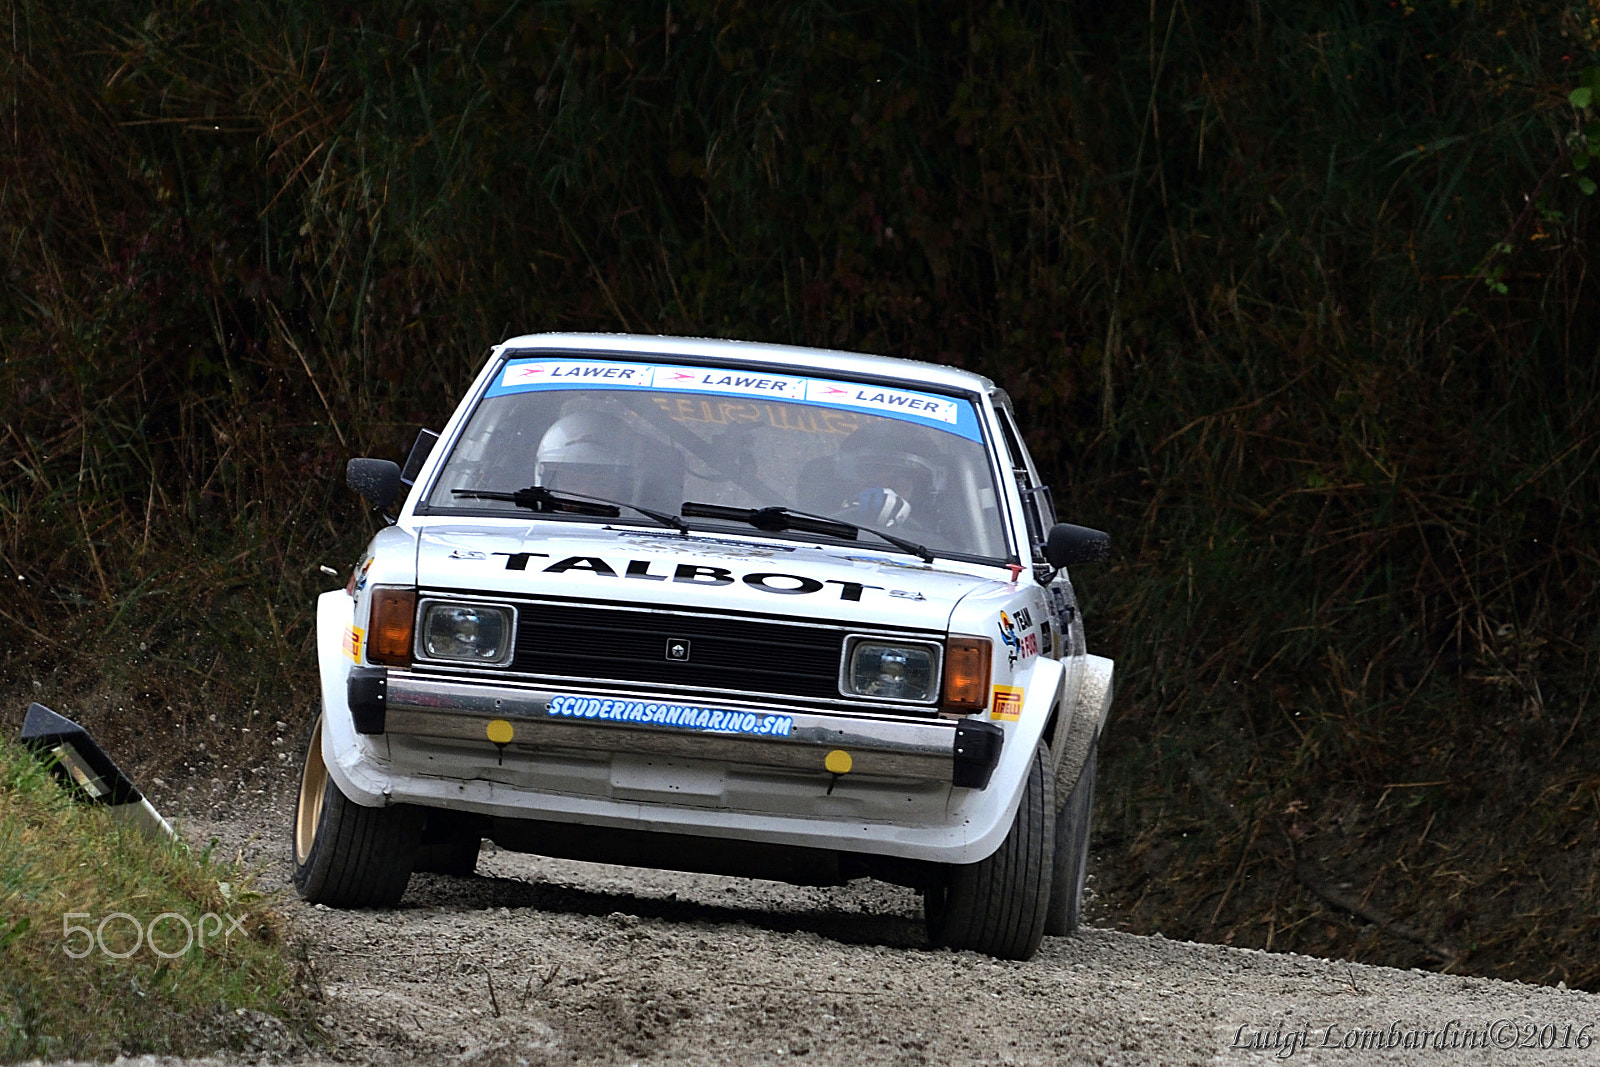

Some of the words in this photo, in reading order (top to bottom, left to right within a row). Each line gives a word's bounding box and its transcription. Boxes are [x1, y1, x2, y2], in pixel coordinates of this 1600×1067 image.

[550, 367, 636, 381] LAWER
[702, 374, 788, 391] LAWER
[856, 391, 940, 412] LAWER
[493, 552, 883, 602] TALBOT
[1013, 607, 1033, 632] TEAM
[992, 692, 1021, 715] PIRELLI
[547, 695, 793, 736] SCUDERIASANMARINO.SM
